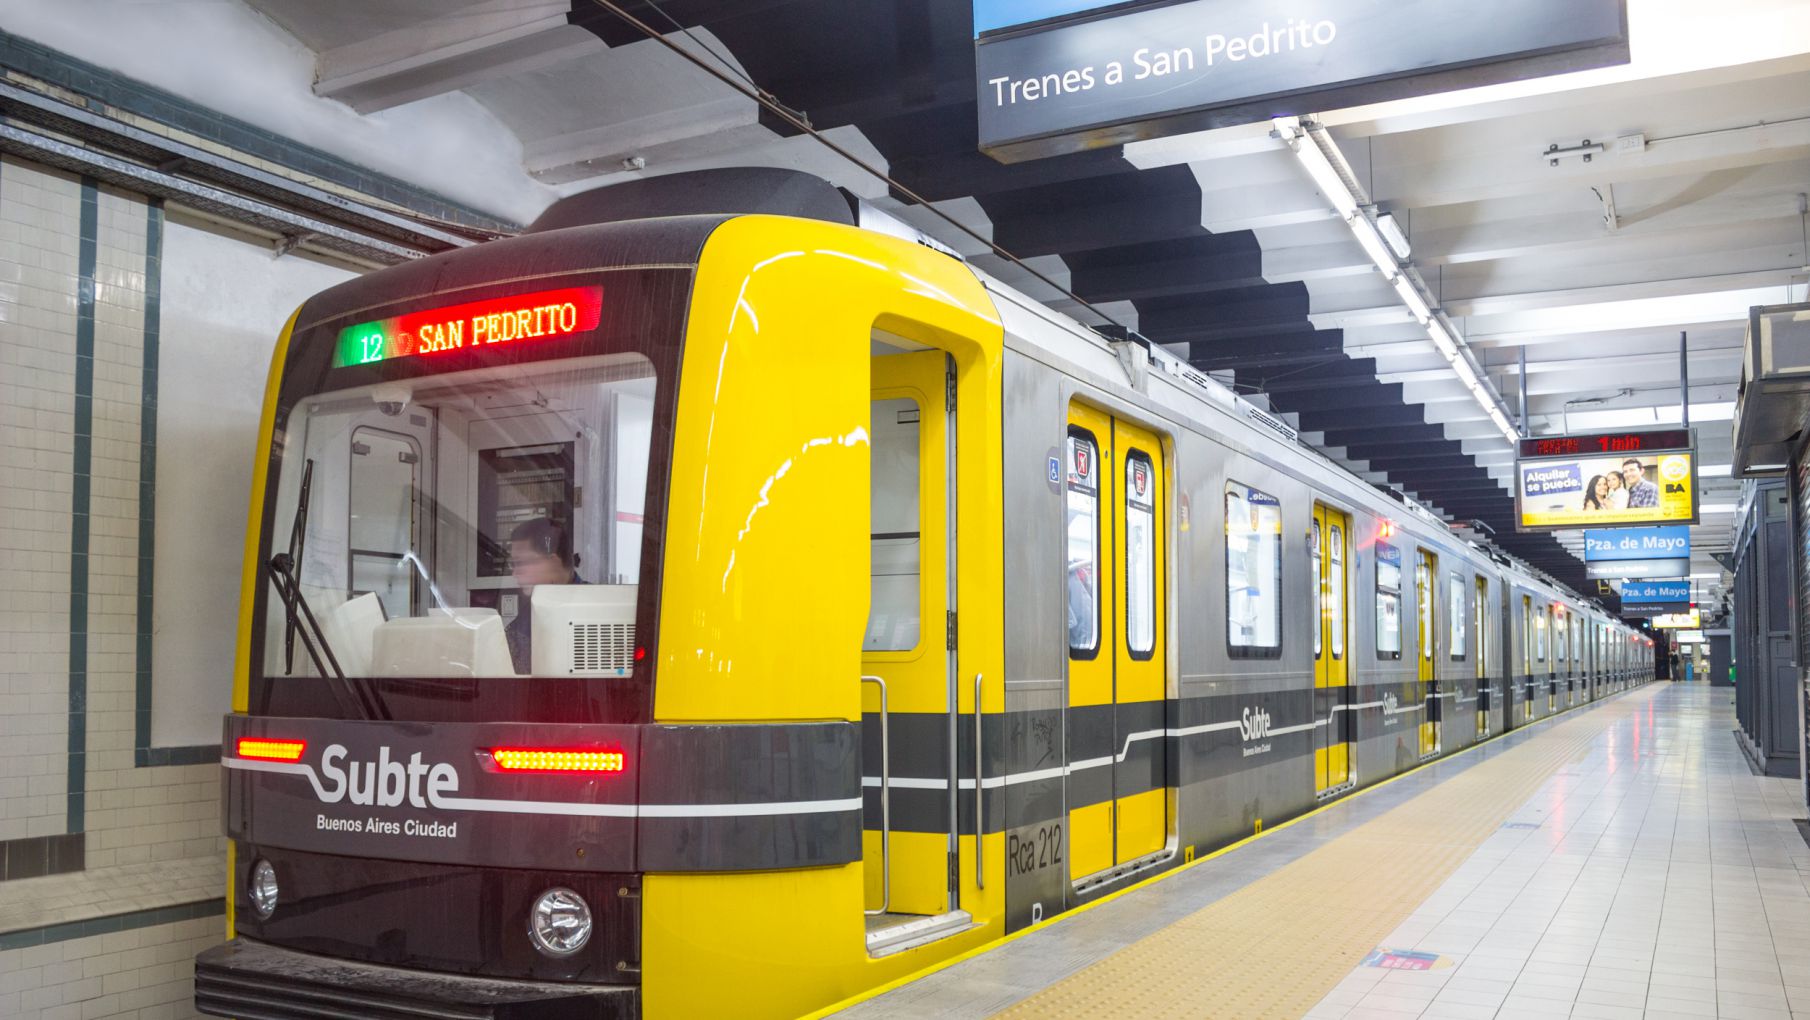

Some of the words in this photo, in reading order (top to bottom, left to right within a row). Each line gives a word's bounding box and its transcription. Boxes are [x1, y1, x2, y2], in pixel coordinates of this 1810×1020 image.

[989, 66, 1095, 107] Trenes
[1104, 60, 1124, 85] a
[1133, 44, 1195, 80] San
[1204, 17, 1337, 67] Pedrito
[360, 333, 383, 363] 12
[419, 319, 464, 354] SAN
[471, 302, 577, 346] PEDRITO
[1612, 435, 1640, 450] min
[1526, 469, 1570, 482] Alquilar
[1527, 483, 1540, 492] se
[1542, 477, 1581, 492] puede.
[1586, 537, 1616, 551] Pza.
[1620, 536, 1638, 549] de
[1643, 536, 1686, 551] Mayo
[1622, 588, 1642, 597] Pza.
[1644, 587, 1657, 596] de
[1659, 586, 1688, 598] Mayo
[1242, 705, 1270, 742] Subte
[317, 743, 459, 810] Subte
[316, 814, 362, 833] Buenos
[365, 816, 401, 835] Aires
[404, 818, 457, 839] Ciudad
[1009, 832, 1036, 880] Rca
[1038, 824, 1063, 869] 212
